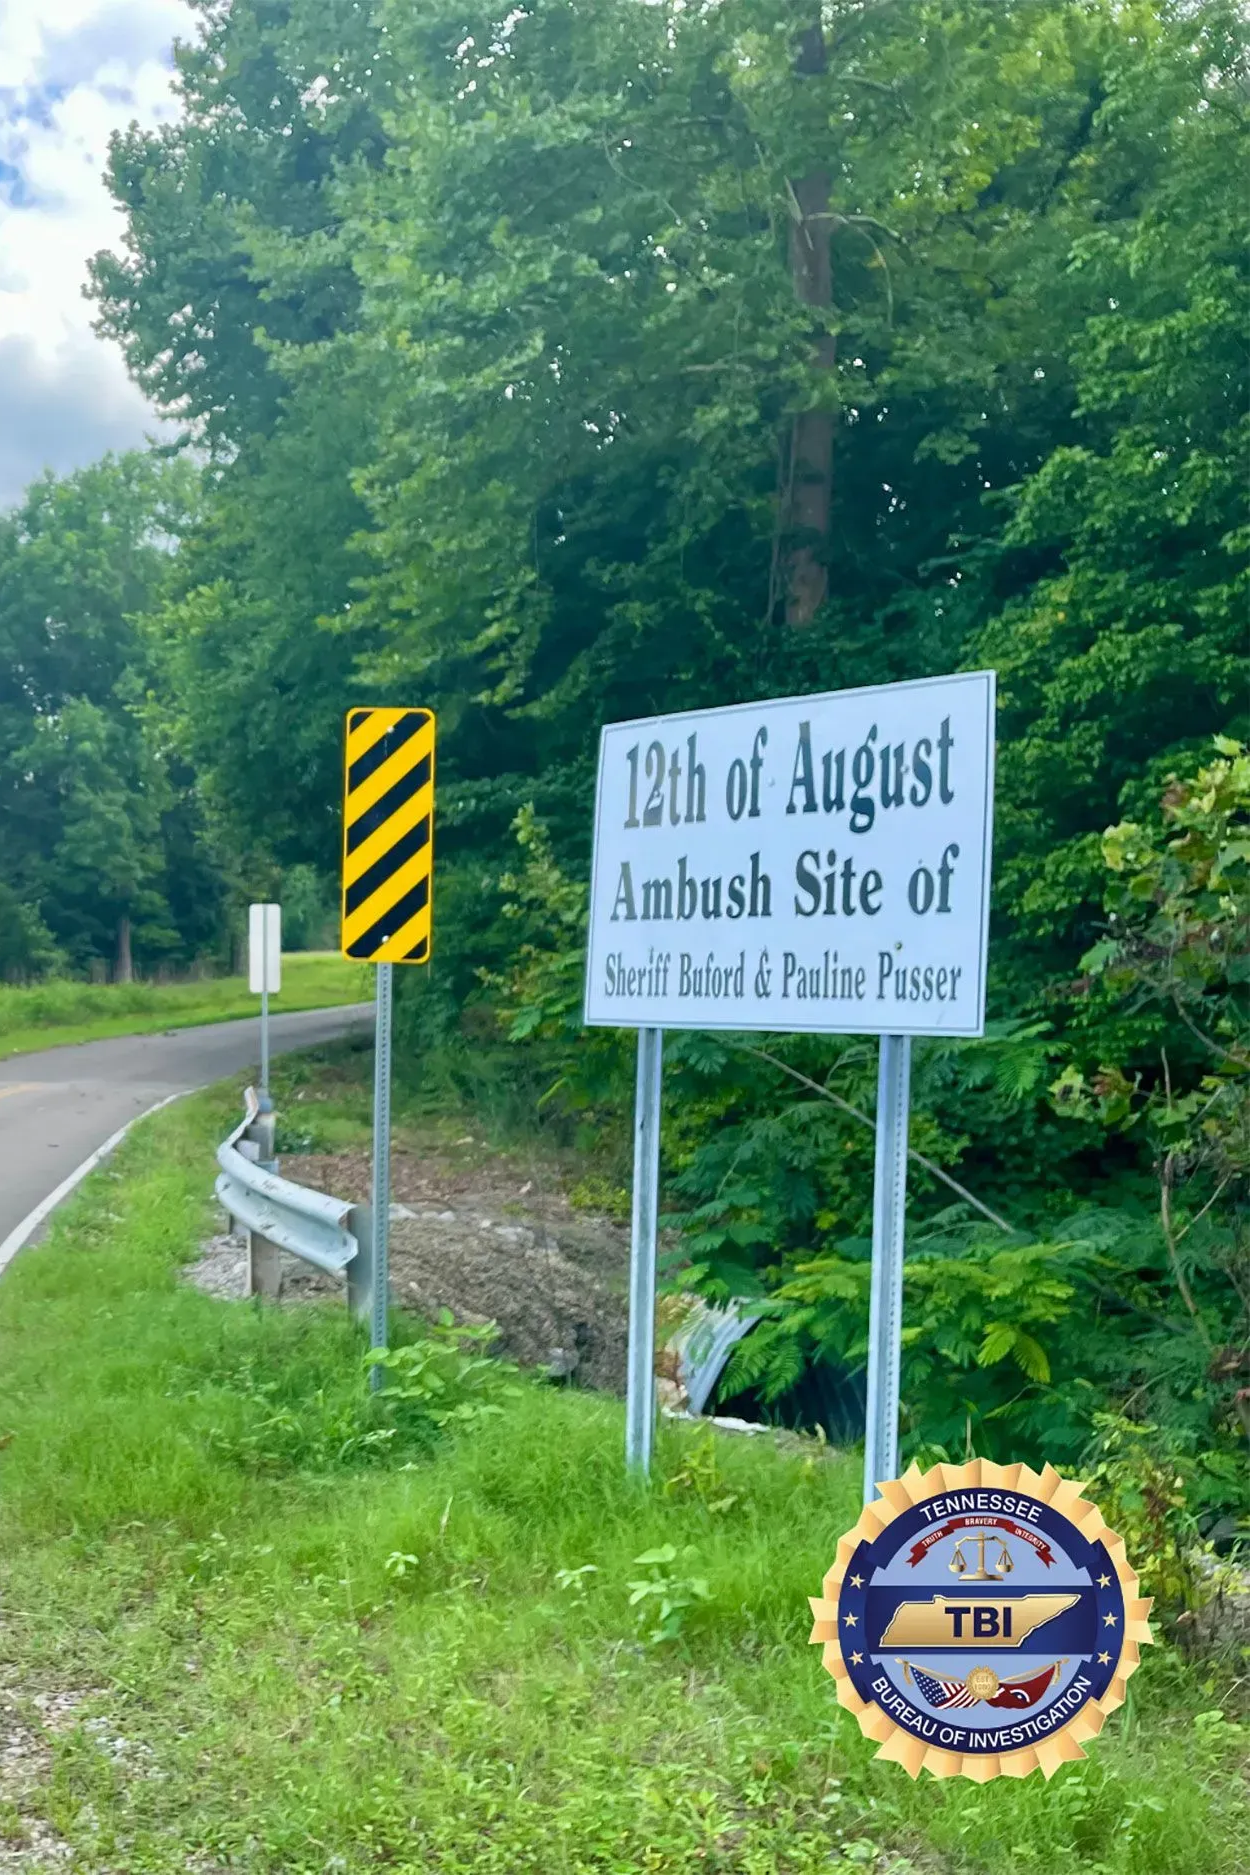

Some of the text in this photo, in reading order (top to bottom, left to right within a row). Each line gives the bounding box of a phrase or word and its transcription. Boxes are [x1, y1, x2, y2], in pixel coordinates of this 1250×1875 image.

[623, 714, 955, 834] 12th of August
[610, 842, 959, 921] Ambush Site of
[604, 945, 961, 1001] Sheriff Buford & Pauline Pusser
